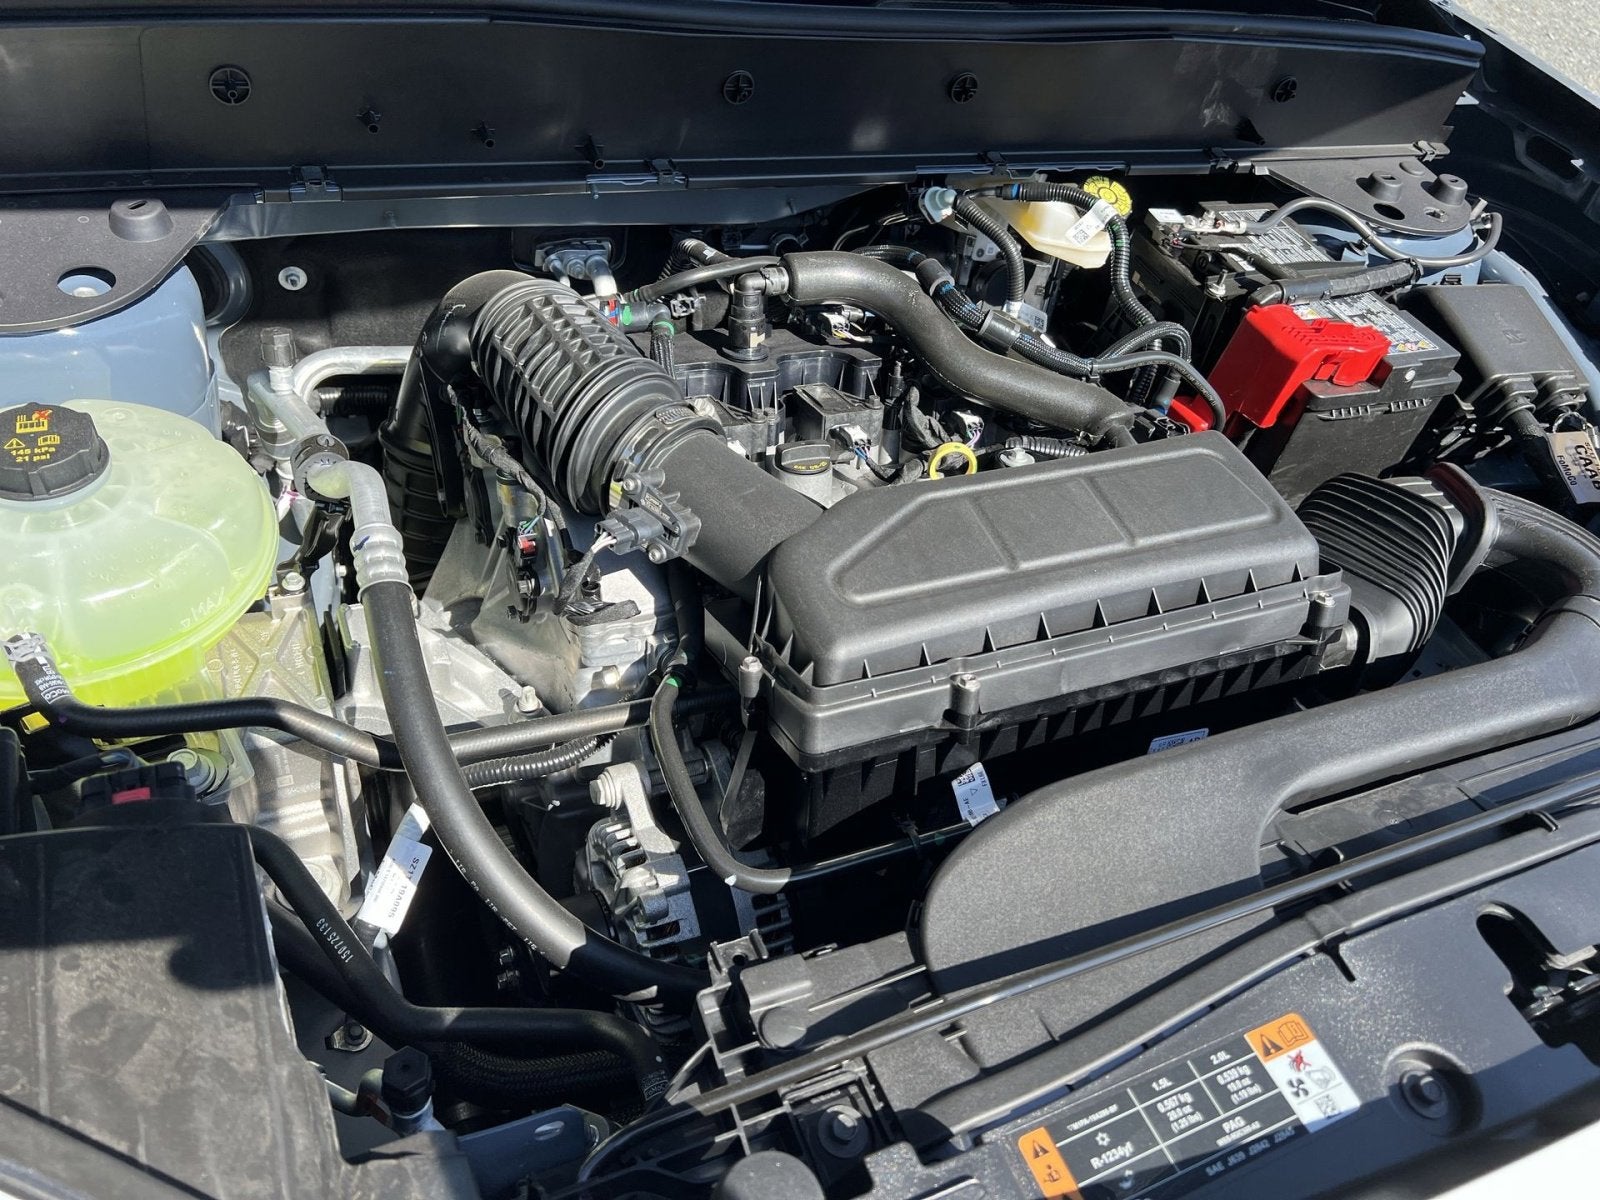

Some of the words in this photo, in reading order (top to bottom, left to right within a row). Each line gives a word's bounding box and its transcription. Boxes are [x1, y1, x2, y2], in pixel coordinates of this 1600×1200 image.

[1557, 455, 1577, 485] FoMoCo
[1210, 1050, 1231, 1065] 2.0L
[1237, 1063, 1252, 1078] kg
[1178, 1090, 1193, 1105] kg
[1222, 1116, 1246, 1132] PAG
[1089, 1141, 1134, 1170] R-1234yf
[1205, 1161, 1225, 1177] SAE
